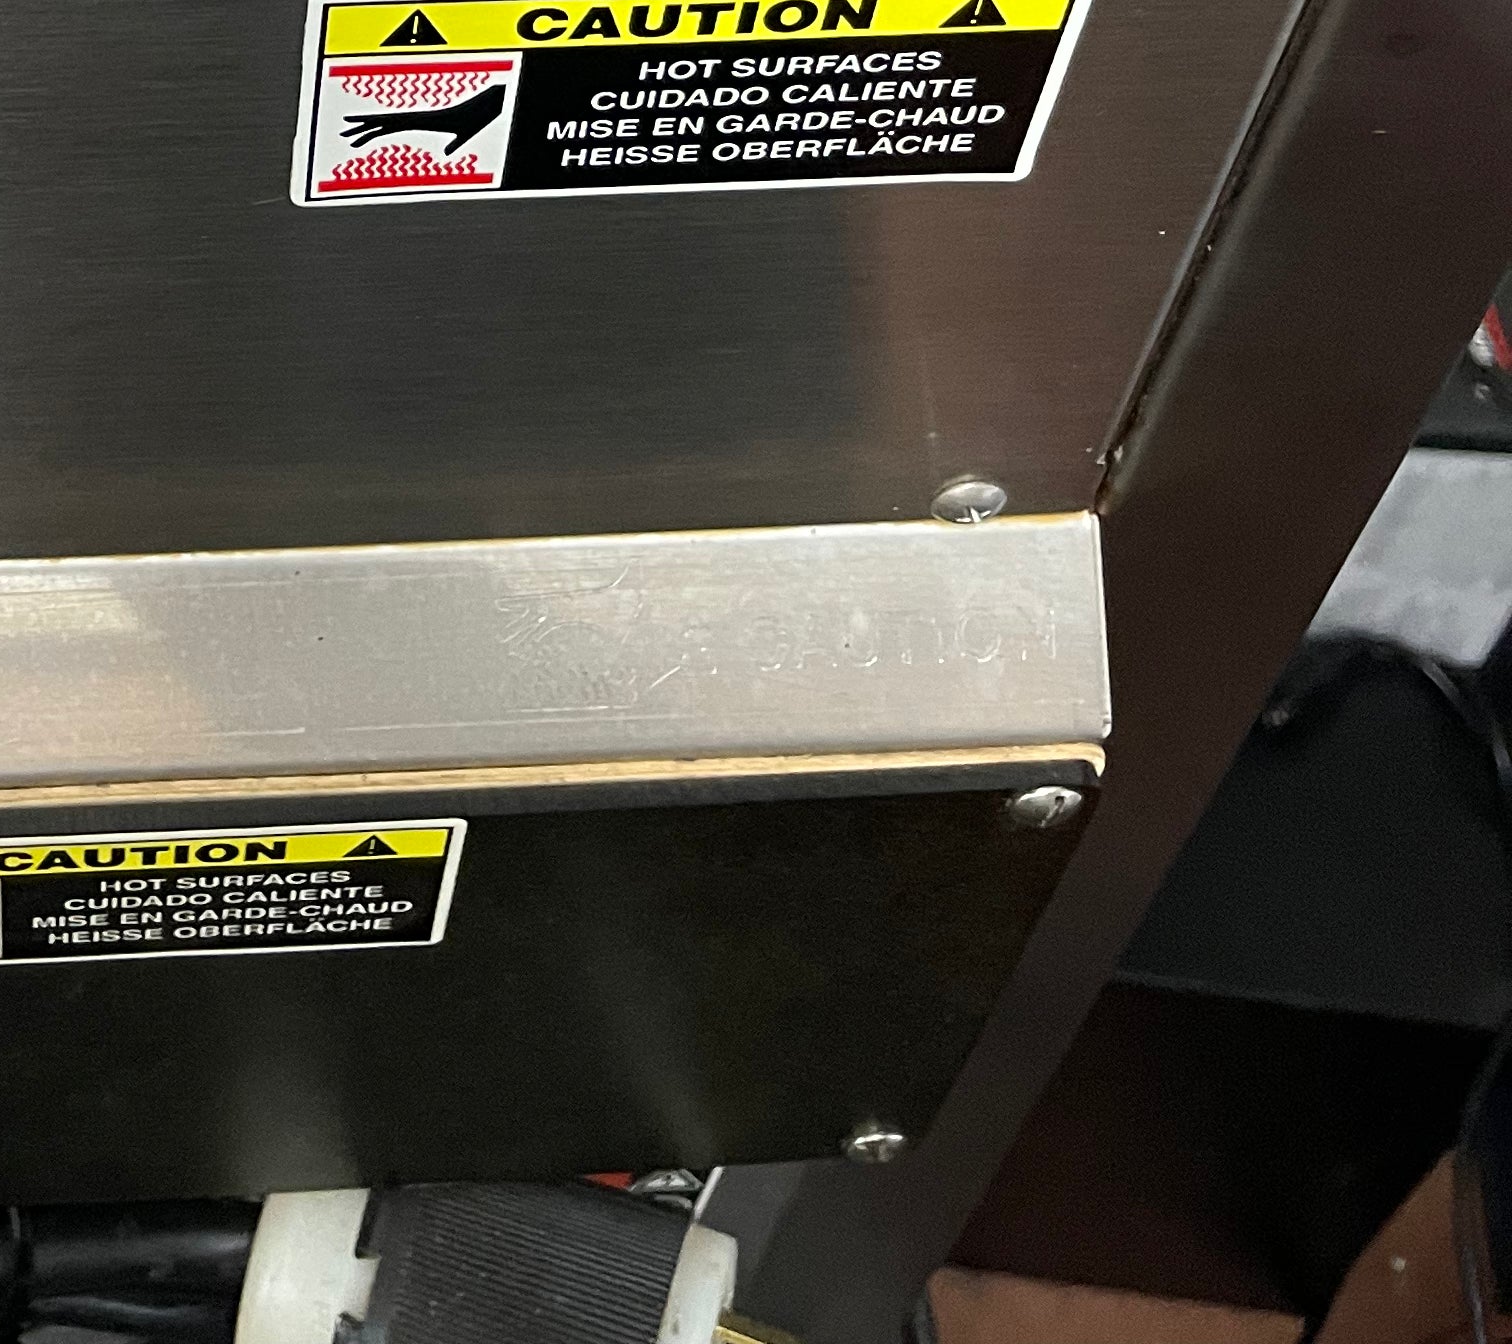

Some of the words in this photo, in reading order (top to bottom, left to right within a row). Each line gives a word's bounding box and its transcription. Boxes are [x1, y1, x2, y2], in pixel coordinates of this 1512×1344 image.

[638, 58, 721, 81] HOT
[731, 50, 942, 78] SURFACES
[590, 86, 769, 110] CUIDADO
[782, 78, 976, 102] CALIENTE
[546, 117, 640, 140] MISE
[654, 114, 708, 136] EN
[715, 105, 1006, 134] GARDE-CHAUD
[560, 142, 701, 168] HEISSE
[711, 130, 975, 162] OBERFLÄCHE
[99, 876, 167, 893] HOT
[176, 870, 351, 890] SURFACES
[63, 894, 214, 911] CUIDADO
[222, 886, 385, 904] CALIENTE
[30, 912, 110, 930] MISE
[120, 909, 163, 926] EN
[172, 900, 414, 924] GARDE-CHAUD
[48, 928, 163, 945] HEISSE
[172, 916, 393, 941] OBERFLÄCHE
